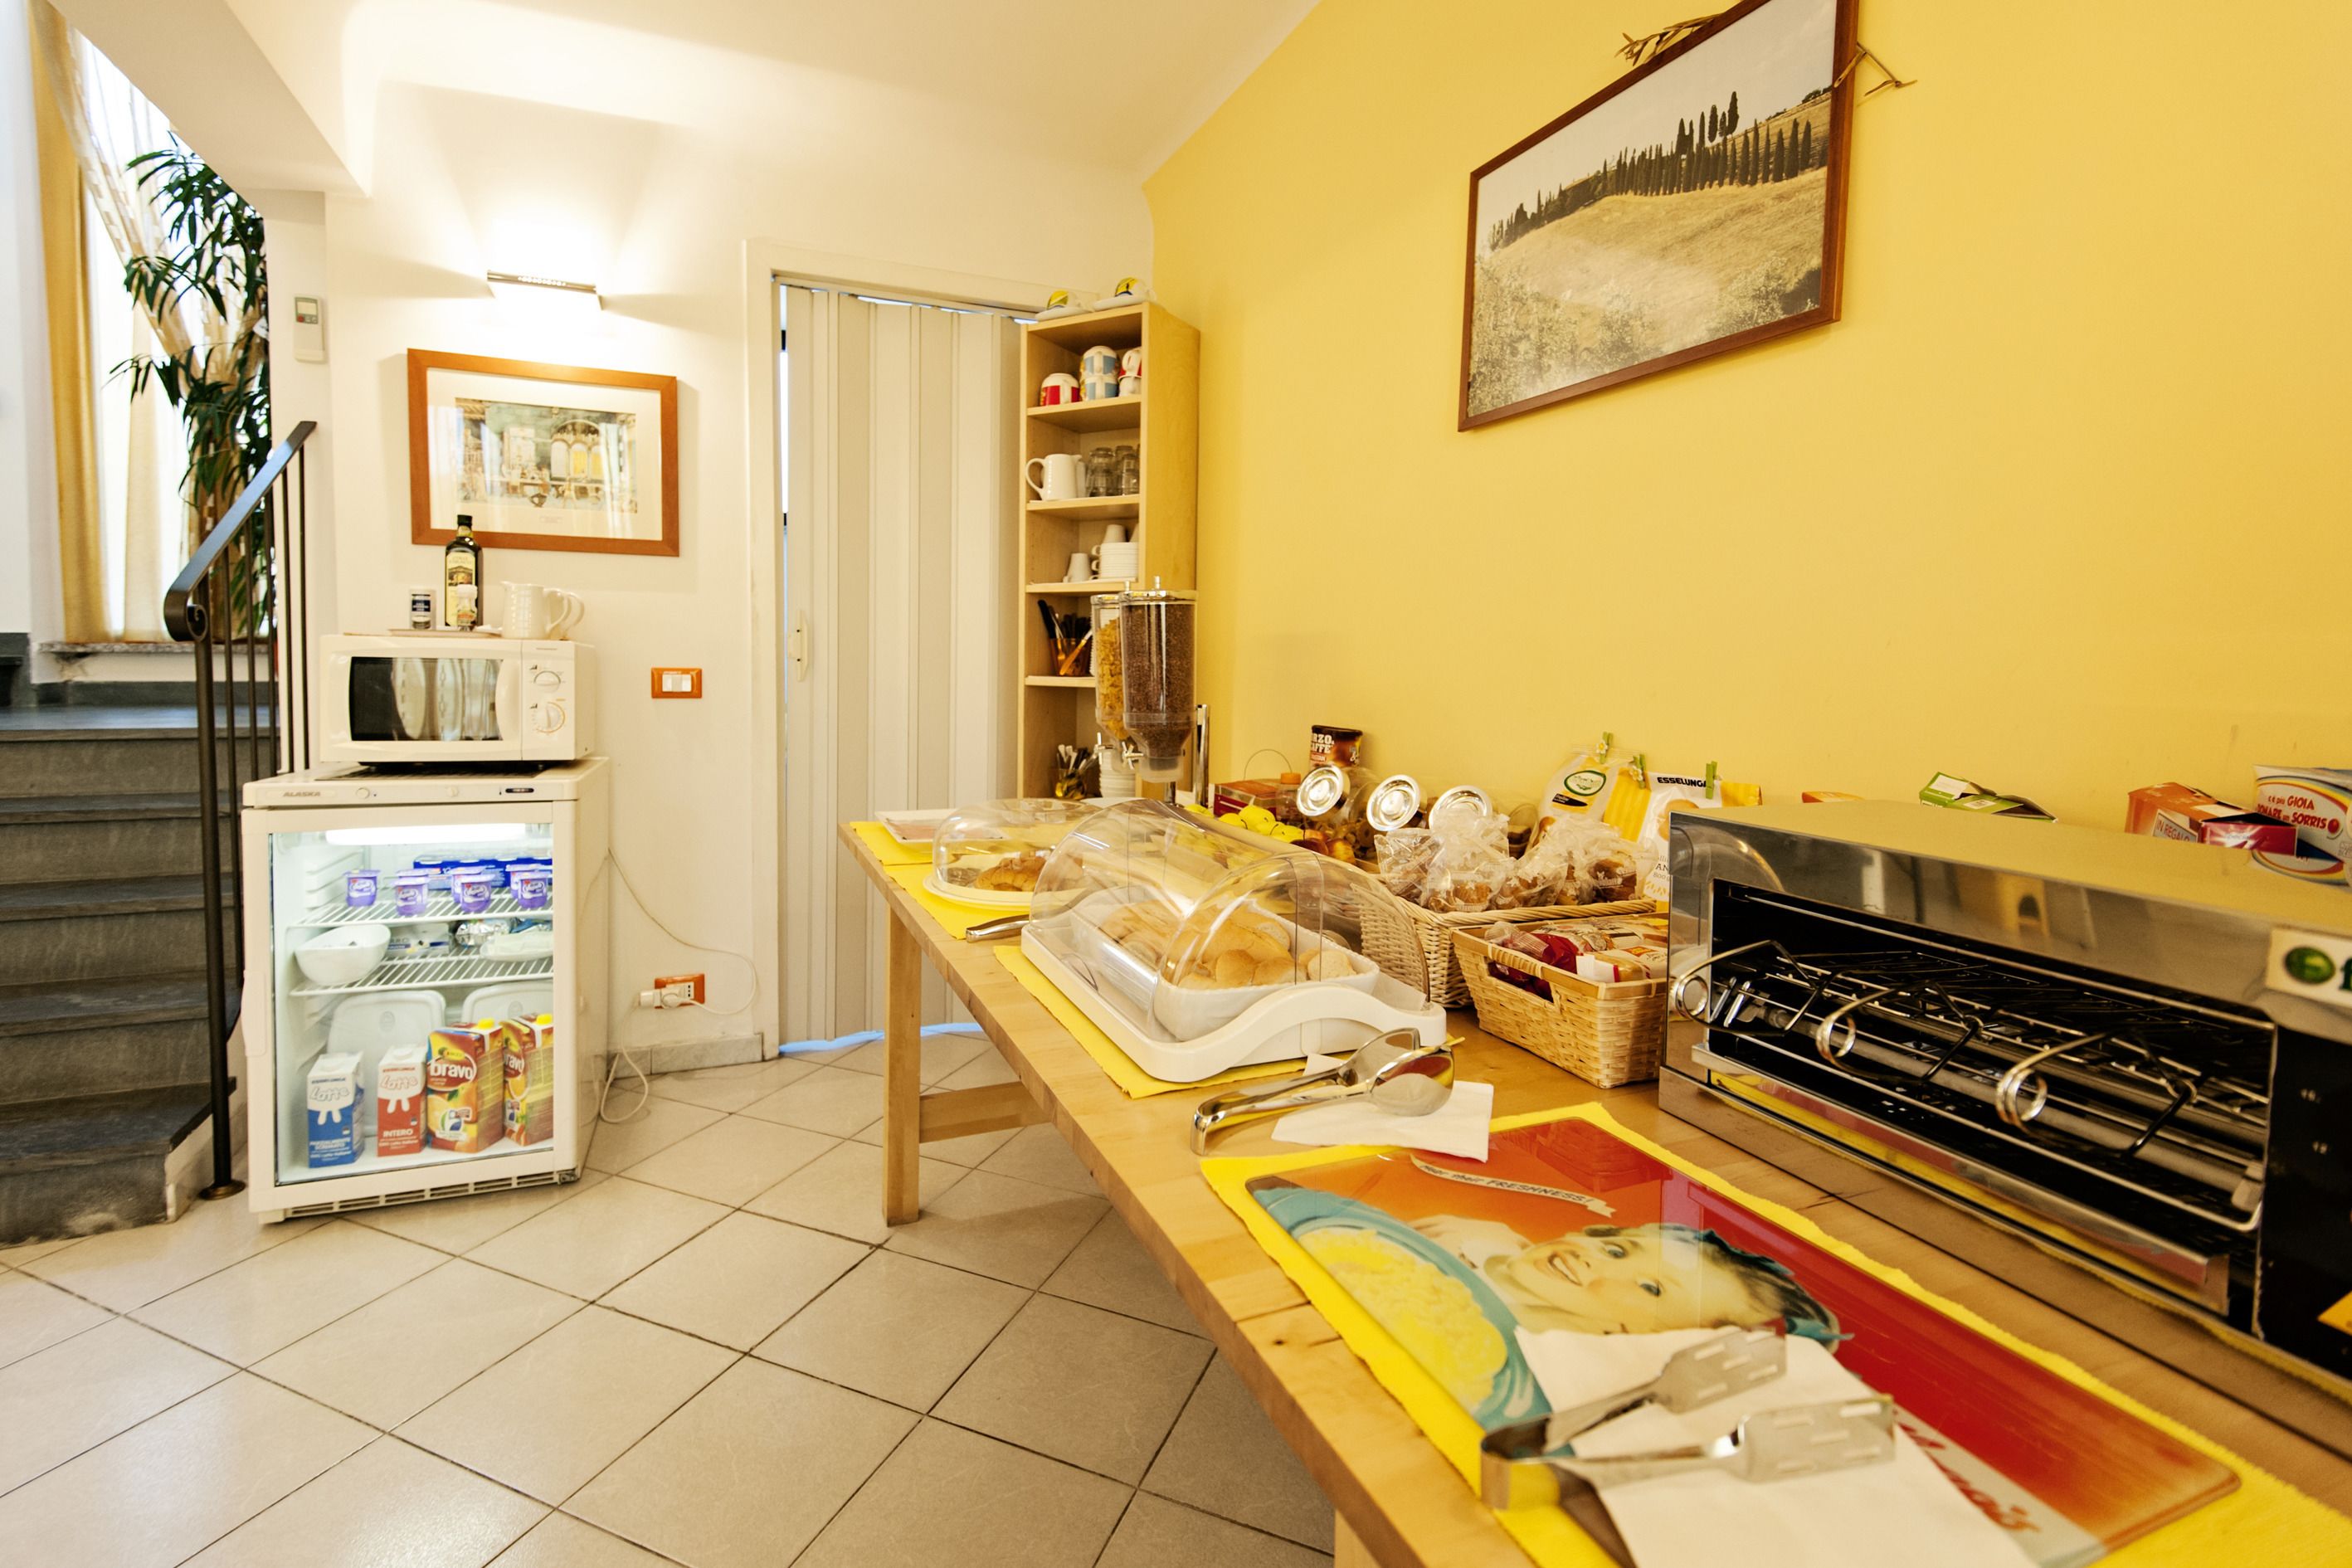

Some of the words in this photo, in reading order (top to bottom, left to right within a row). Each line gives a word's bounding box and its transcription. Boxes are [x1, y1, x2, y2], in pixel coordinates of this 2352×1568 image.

[2287, 796, 2315, 810] GIOIA
[2157, 819, 2165, 832] IN
[429, 1061, 474, 1080] bravo
[382, 1128, 413, 1137] INTERO
[1486, 1179, 1595, 1204] FRESHNESS!
